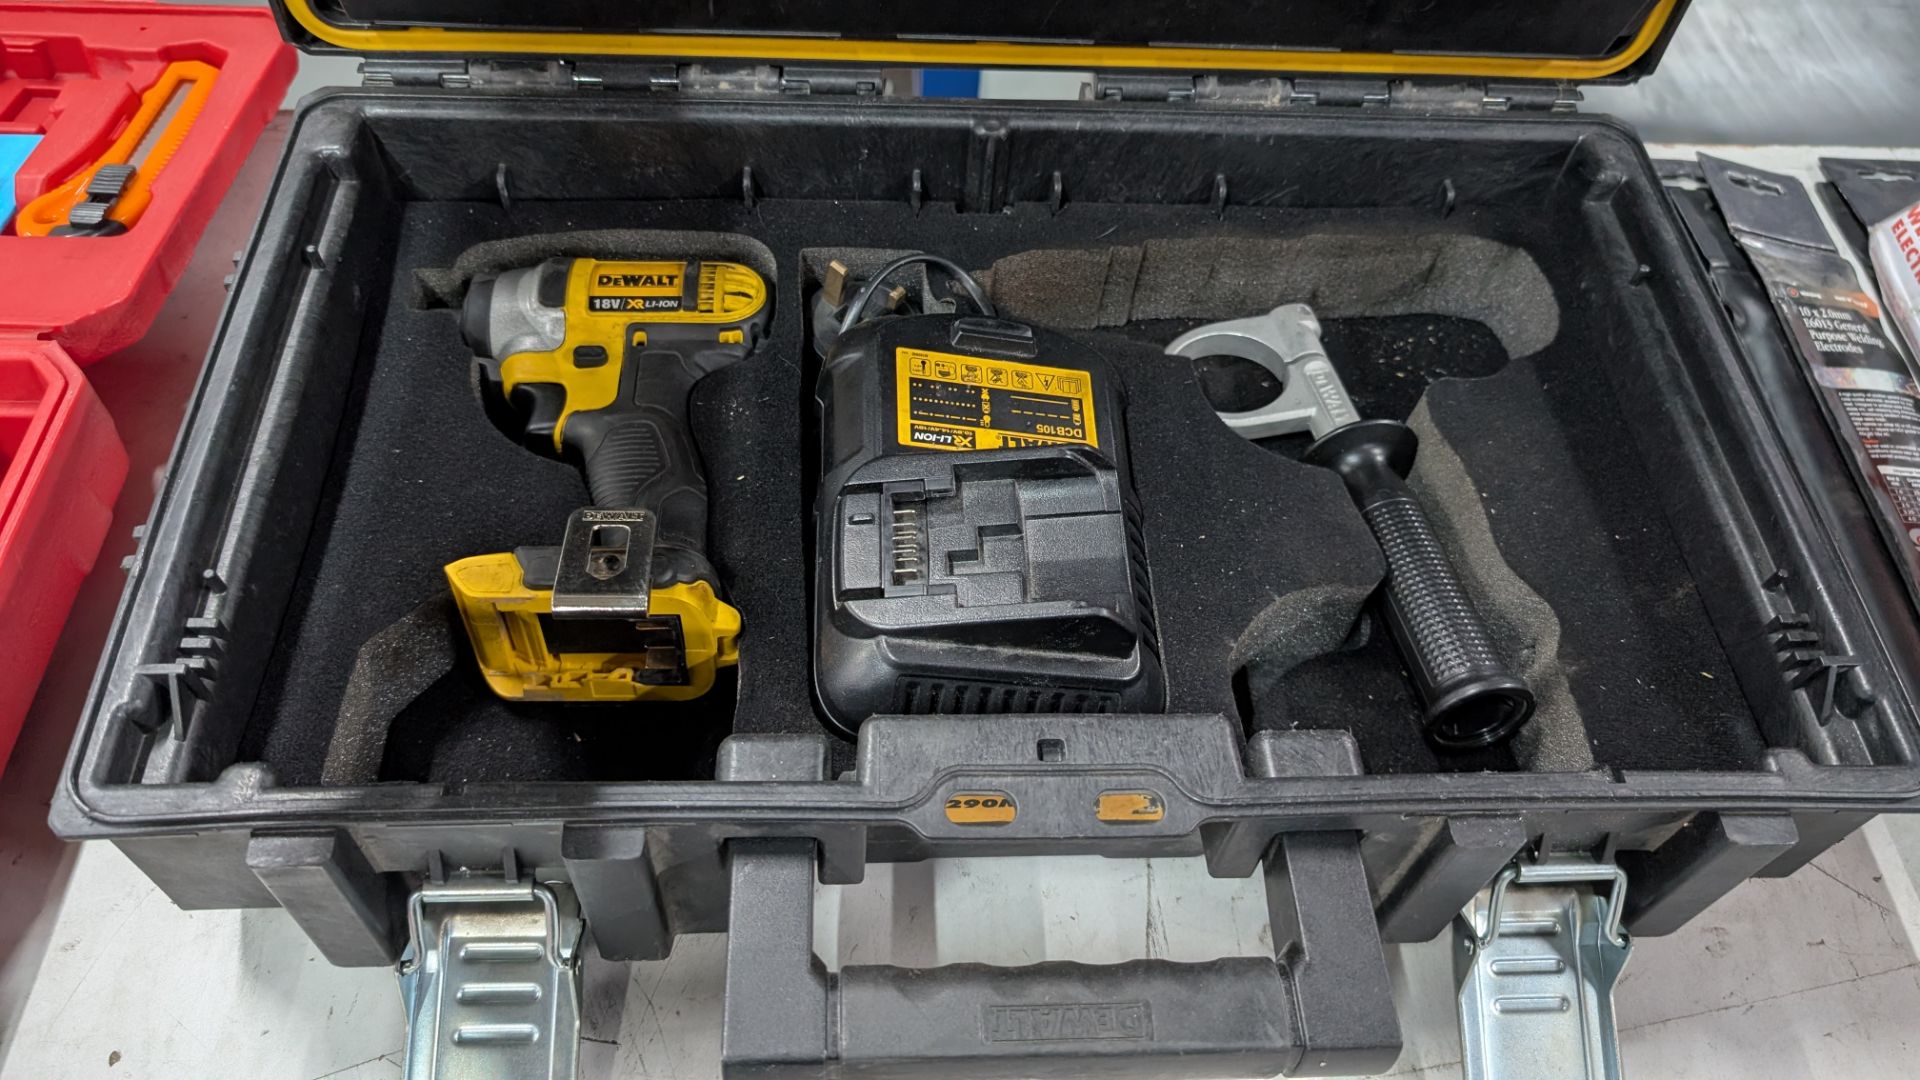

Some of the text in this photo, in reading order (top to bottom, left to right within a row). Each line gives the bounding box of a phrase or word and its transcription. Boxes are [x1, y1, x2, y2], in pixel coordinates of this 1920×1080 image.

[645, 299, 679, 309] LI-ION
[1799, 306, 1812, 317] 10
[1834, 321, 1870, 334] General
[1808, 329, 1885, 349] Purpose Welding
[1814, 340, 1864, 354] Electrodes
[1036, 423, 1083, 438] DCB105
[914, 431, 973, 447] XR LI-ION
